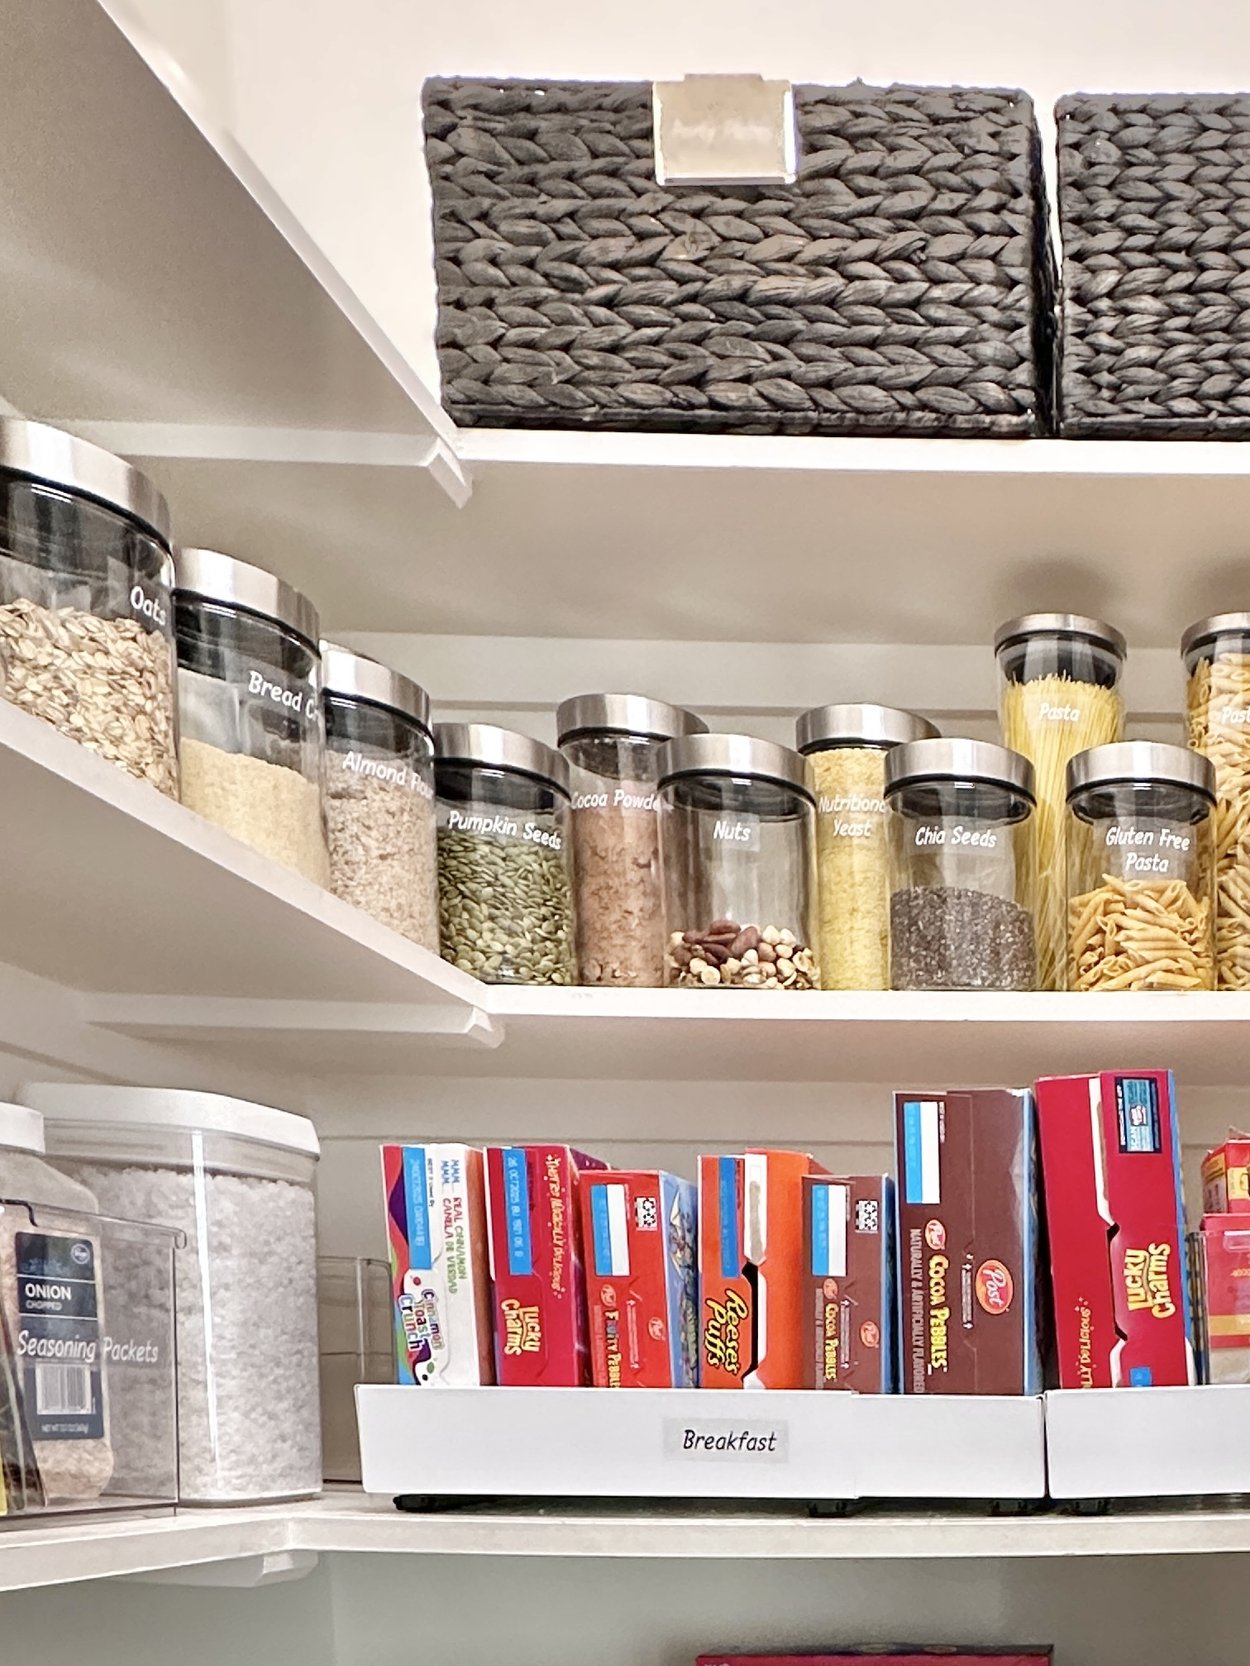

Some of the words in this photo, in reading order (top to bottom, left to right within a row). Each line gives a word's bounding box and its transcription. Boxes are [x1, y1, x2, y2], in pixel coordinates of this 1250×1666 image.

[130, 586, 166, 625] Oats
[249, 670, 302, 711] Bread
[1039, 703, 1081, 723] Pasta
[342, 752, 405, 786] Almond
[570, 792, 608, 808] Cocoa
[819, 796, 887, 814] Nutritiona
[449, 811, 517, 836] Pumpkin
[523, 821, 561, 850] Seeds
[713, 821, 751, 842] Nuts
[833, 819, 872, 838] Yeast
[915, 825, 945, 847] Chia
[951, 825, 997, 849] Seeds
[1106, 826, 1154, 847] Gluten
[1159, 828, 1191, 852] Free
[1125, 852, 1169, 873] Pasta
[452, 1197, 463, 1222] REAL
[454, 1225, 466, 1280] CINNAMON
[910, 1228, 923, 1279] NATURALLY
[25, 1282, 72, 1301] ONION
[929, 1254, 950, 1305] COCOA
[982, 1268, 1007, 1306] Post
[1123, 1247, 1154, 1311] Lucky
[1147, 1242, 1176, 1319] Charms
[26, 1300, 63, 1312] CHOPPED
[399, 1294, 426, 1351] Crunch
[414, 1301, 432, 1342] Toast
[423, 1289, 446, 1350] Cinnamon
[824, 1303, 838, 1337] COCOA
[911, 1288, 924, 1346] ARTIFICIALLY
[17, 1330, 96, 1363] Seasoning
[103, 1336, 159, 1363] Packets
[500, 1298, 524, 1356] Charms
[521, 1306, 542, 1353] Lucky
[603, 1310, 620, 1351] FRUITY
[704, 1298, 728, 1369] Puffs
[724, 1290, 749, 1375] Reese's
[928, 1307, 950, 1369] PEBBLES
[1078, 1307, 1092, 1364] DELICIOUS
[824, 1338, 839, 1380] PEBBLES
[912, 1347, 925, 1392] FLAVORED
[683, 1428, 777, 1452] Breakfast
